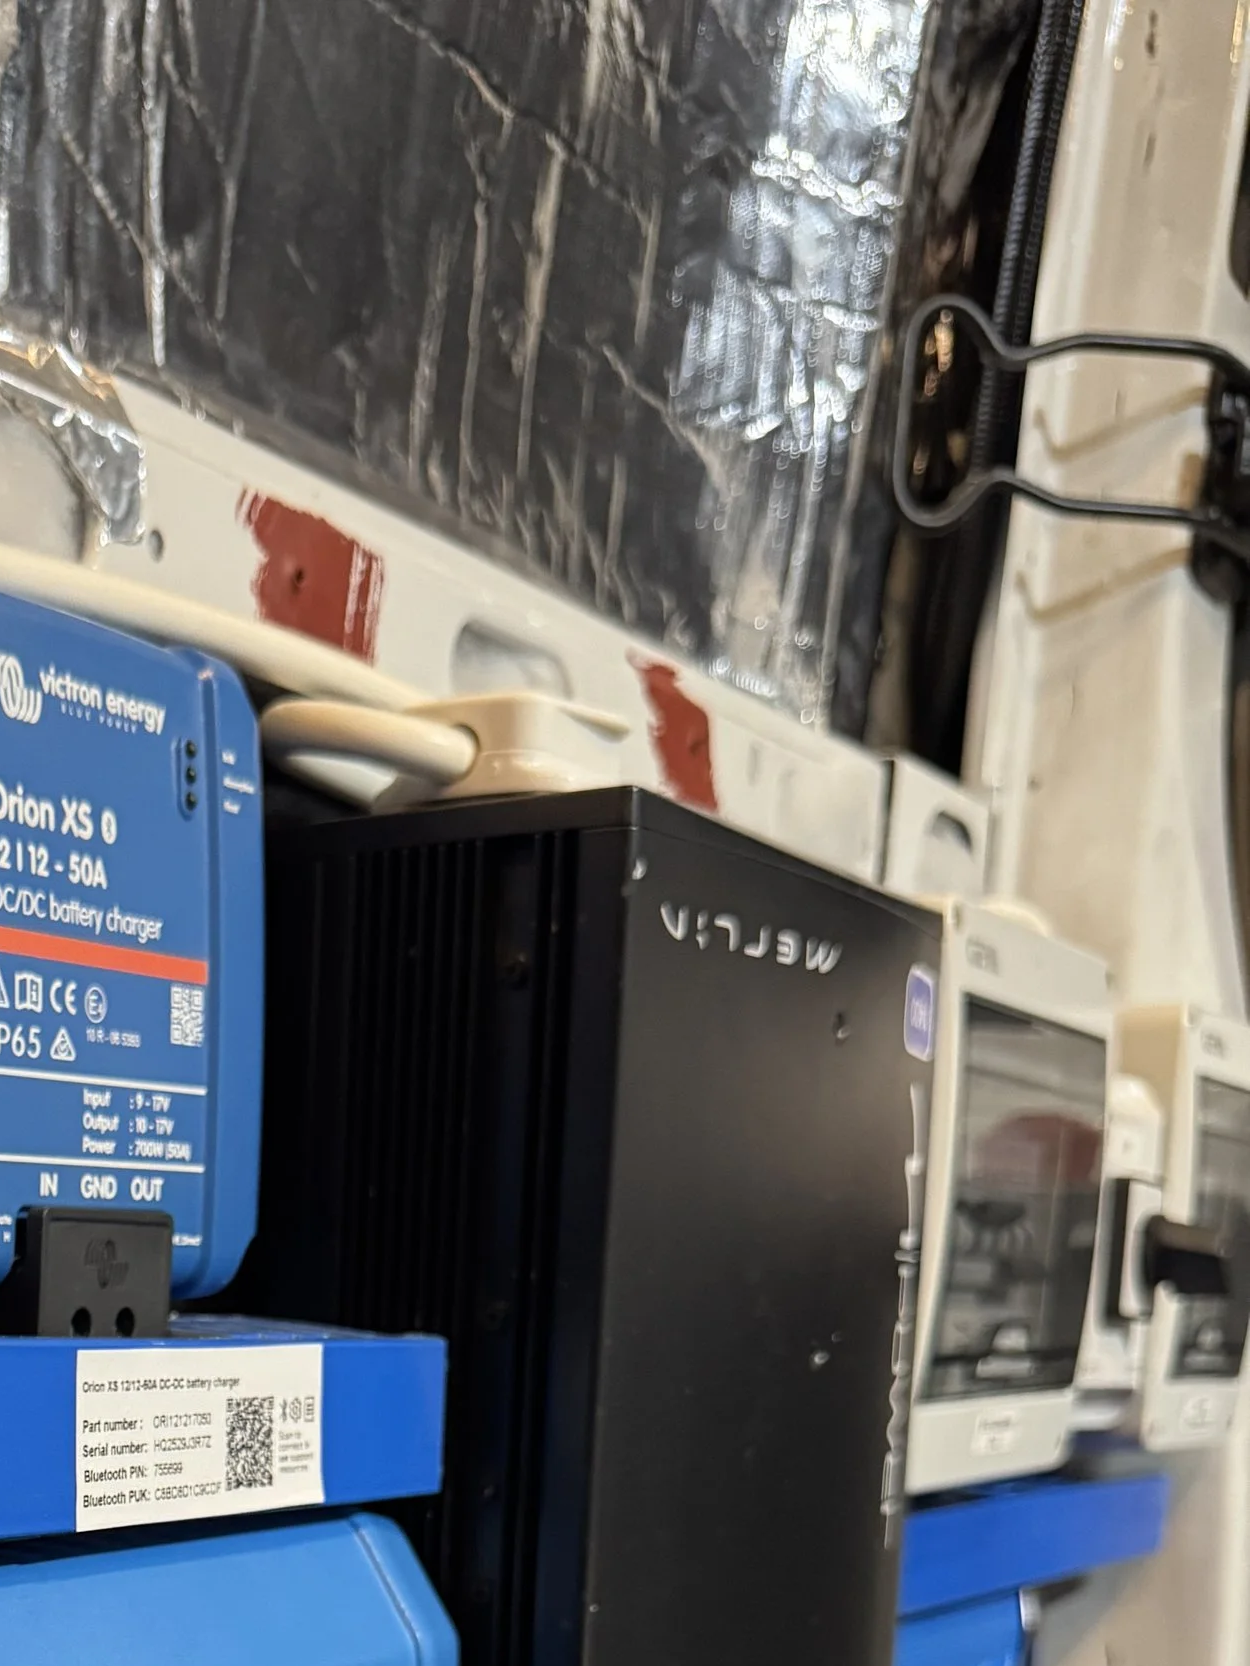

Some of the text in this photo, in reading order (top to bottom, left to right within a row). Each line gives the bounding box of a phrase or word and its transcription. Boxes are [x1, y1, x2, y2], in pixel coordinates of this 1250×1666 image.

[39, 662, 166, 736] victron energy
[61, 797, 95, 841] XS
[27, 842, 50, 878] 12
[68, 851, 108, 890] 50A
[50, 894, 103, 936] battery
[105, 906, 163, 945] charger
[83, 1088, 112, 1110] Input
[82, 1110, 120, 1135] Output
[82, 1134, 117, 1155] Power
[39, 1171, 164, 1202] IN GND OUT
[82, 1380, 106, 1393] Orion
[107, 1380, 119, 1393] XS
[159, 1378, 185, 1390] DC-DC
[186, 1377, 212, 1392] battery
[213, 1376, 240, 1391] charger
[82, 1419, 101, 1434] Part
[103, 1418, 138, 1432] number
[82, 1443, 109, 1458] Serial
[110, 1442, 149, 1456] number:
[84, 1467, 128, 1483] Bluetooth
[129, 1465, 149, 1479] PIN:
[83, 1489, 151, 1508] Bluetooth PUK:
